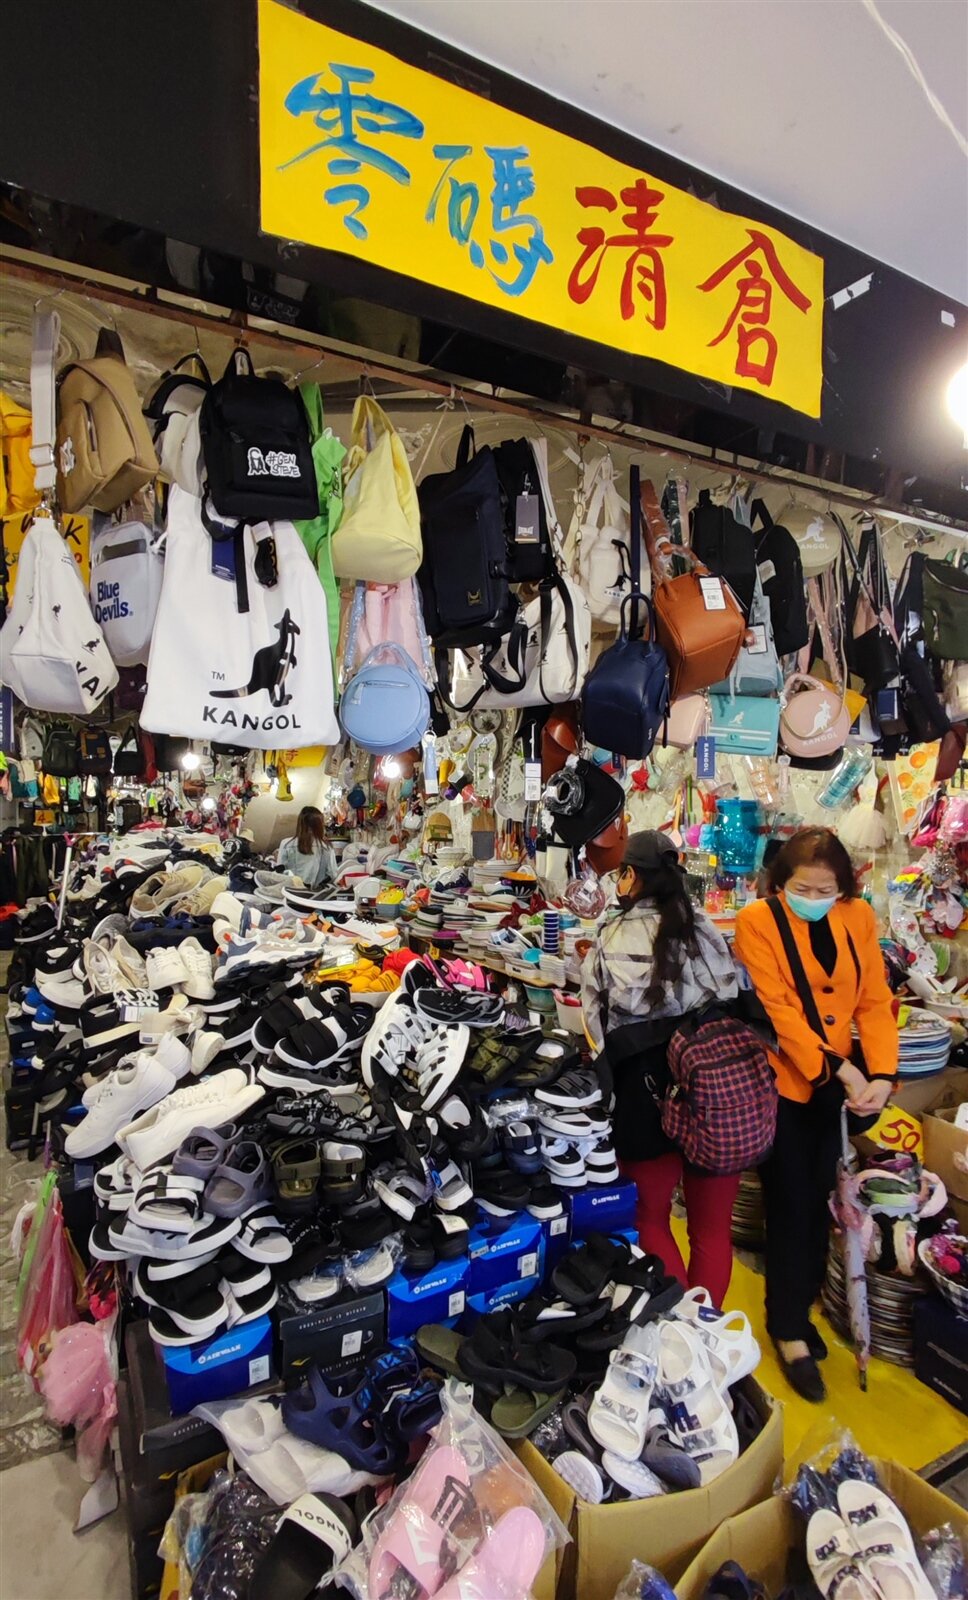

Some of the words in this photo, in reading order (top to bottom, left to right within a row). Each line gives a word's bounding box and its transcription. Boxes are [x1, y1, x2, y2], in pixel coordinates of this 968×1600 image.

[277, 62, 812, 387] 零碼清倉
[97, 581, 120, 603] Blue
[94, 598, 129, 624] Devils
[211, 671, 225, 681] TM
[202, 705, 301, 731] KANGOL
[880, 1119, 920, 1152] 50
